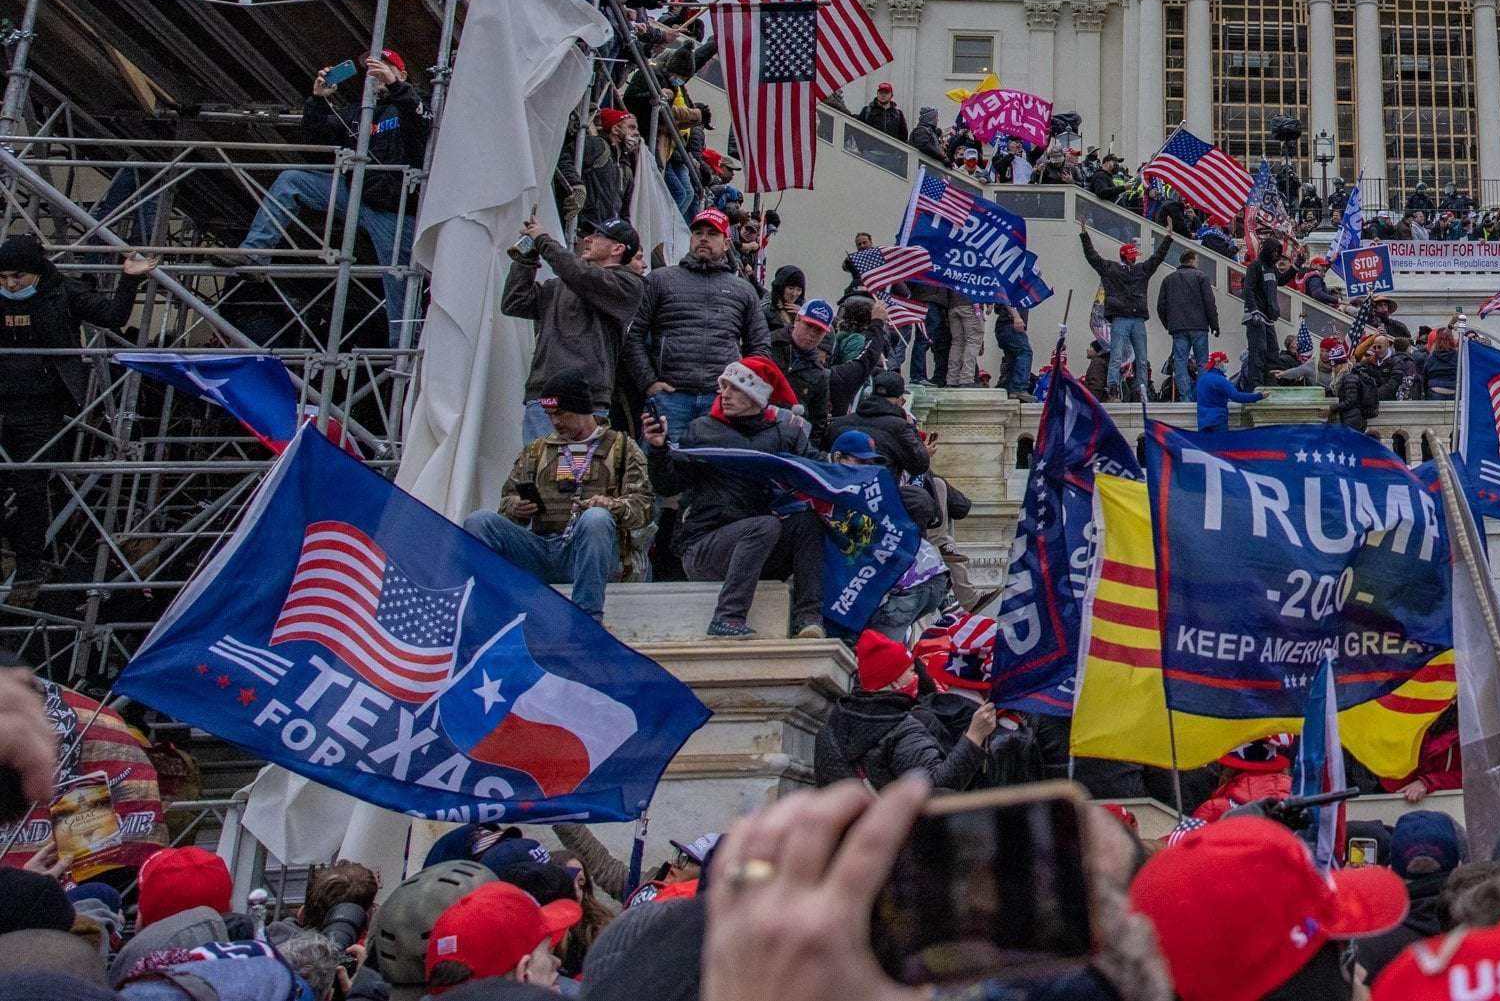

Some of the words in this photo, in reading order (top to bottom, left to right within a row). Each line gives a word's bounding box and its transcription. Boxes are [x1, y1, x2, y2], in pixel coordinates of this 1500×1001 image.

[1419, 243, 1450, 257] FIGHT
[1453, 243, 1474, 257] FOR
[1354, 255, 1379, 270] STOP
[1453, 258, 1499, 268] Republicans
[944, 268, 1000, 287] AMERICA
[1359, 269, 1377, 279] THE
[1350, 279, 1391, 294] STEAL
[1182, 447, 1441, 562] TRUMP
[1176, 625, 1255, 661] KEEP
[1260, 637, 1339, 664] AMERICA
[1344, 631, 1425, 656] GREA
[253, 699, 346, 767] FOR
[295, 655, 515, 799] TEXAS
